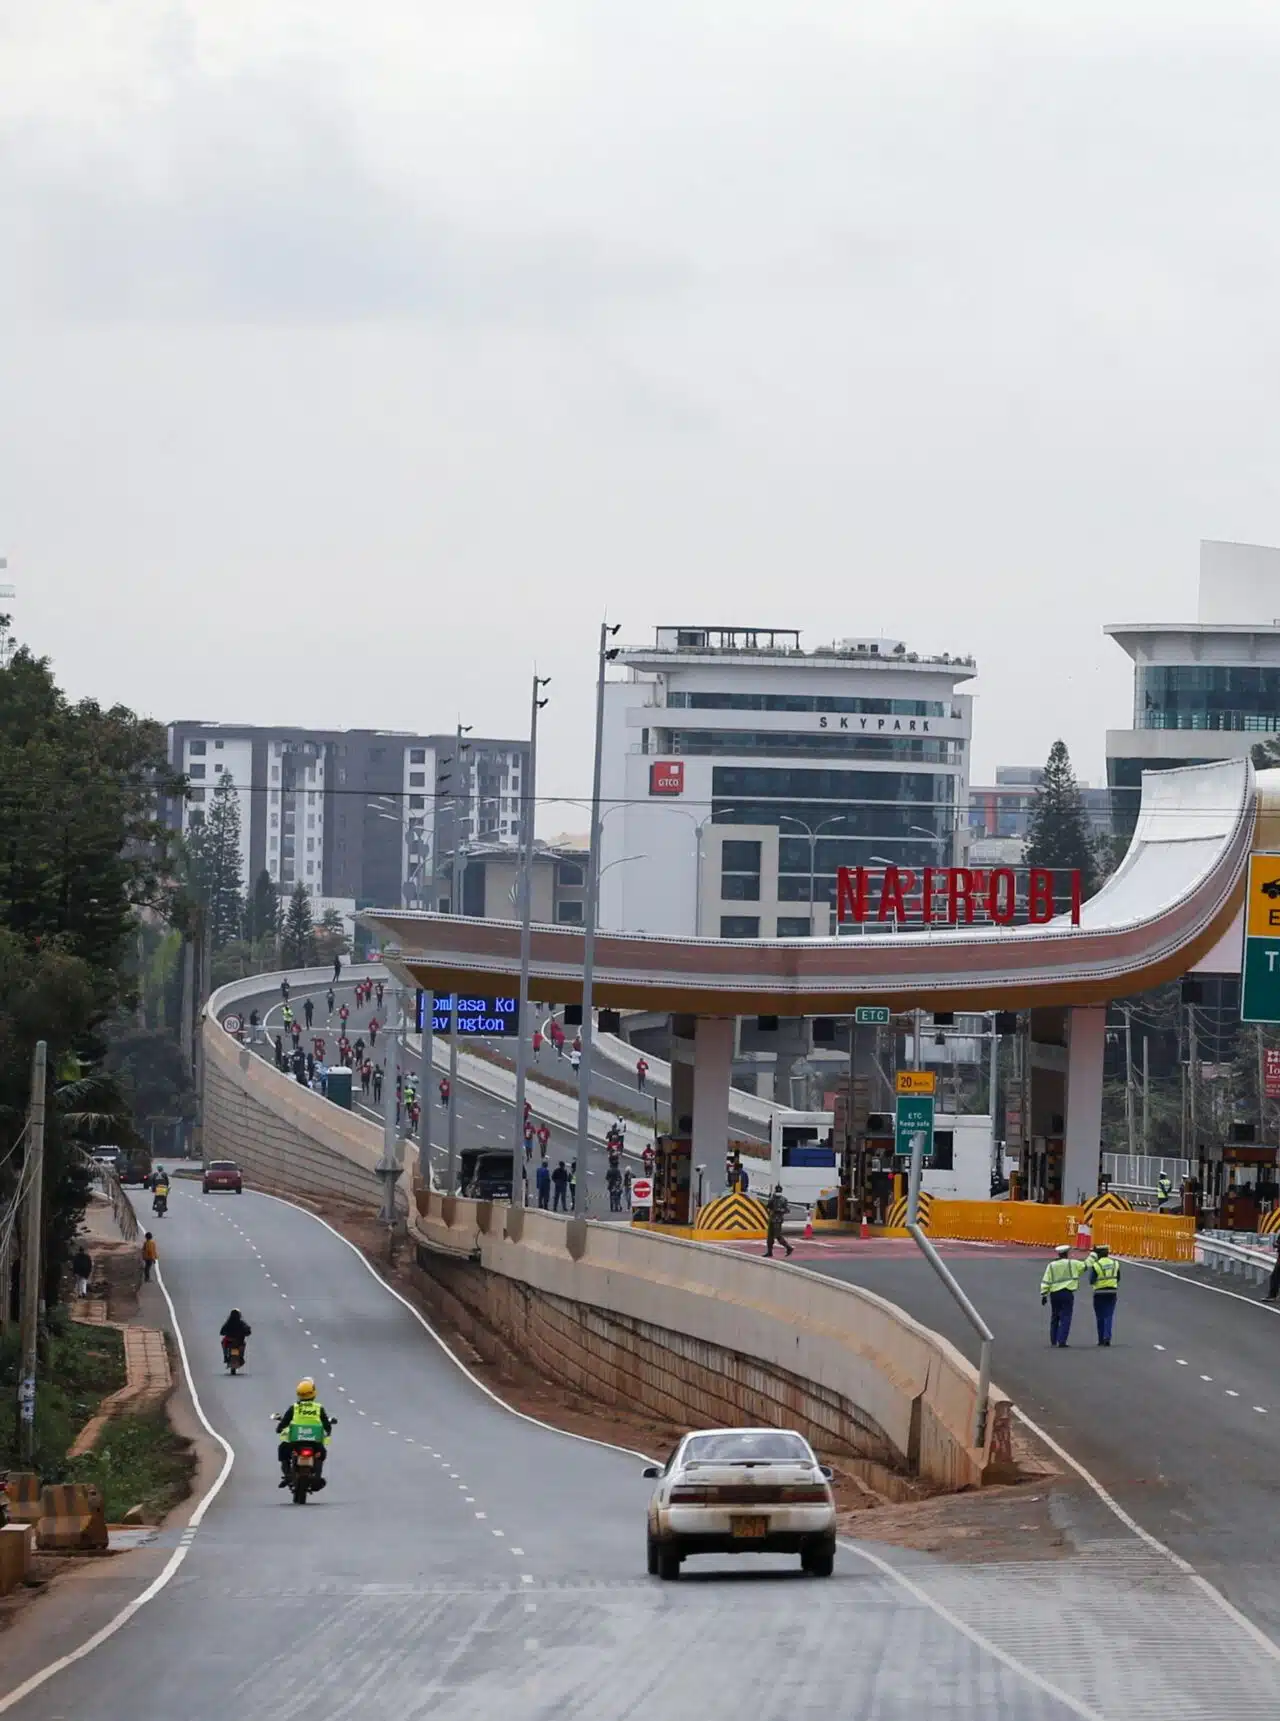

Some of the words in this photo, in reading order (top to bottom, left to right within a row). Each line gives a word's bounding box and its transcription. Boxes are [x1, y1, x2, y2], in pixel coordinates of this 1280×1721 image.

[820, 716, 929, 732] SKYPARK
[836, 866, 1081, 925] NAIROBI
[420, 993, 486, 1011] omasa
[420, 1012, 505, 1031] avngton
[861, 1010, 885, 1021] ETC
[226, 1019, 238, 1029] 80
[901, 1076, 912, 1088] 20
